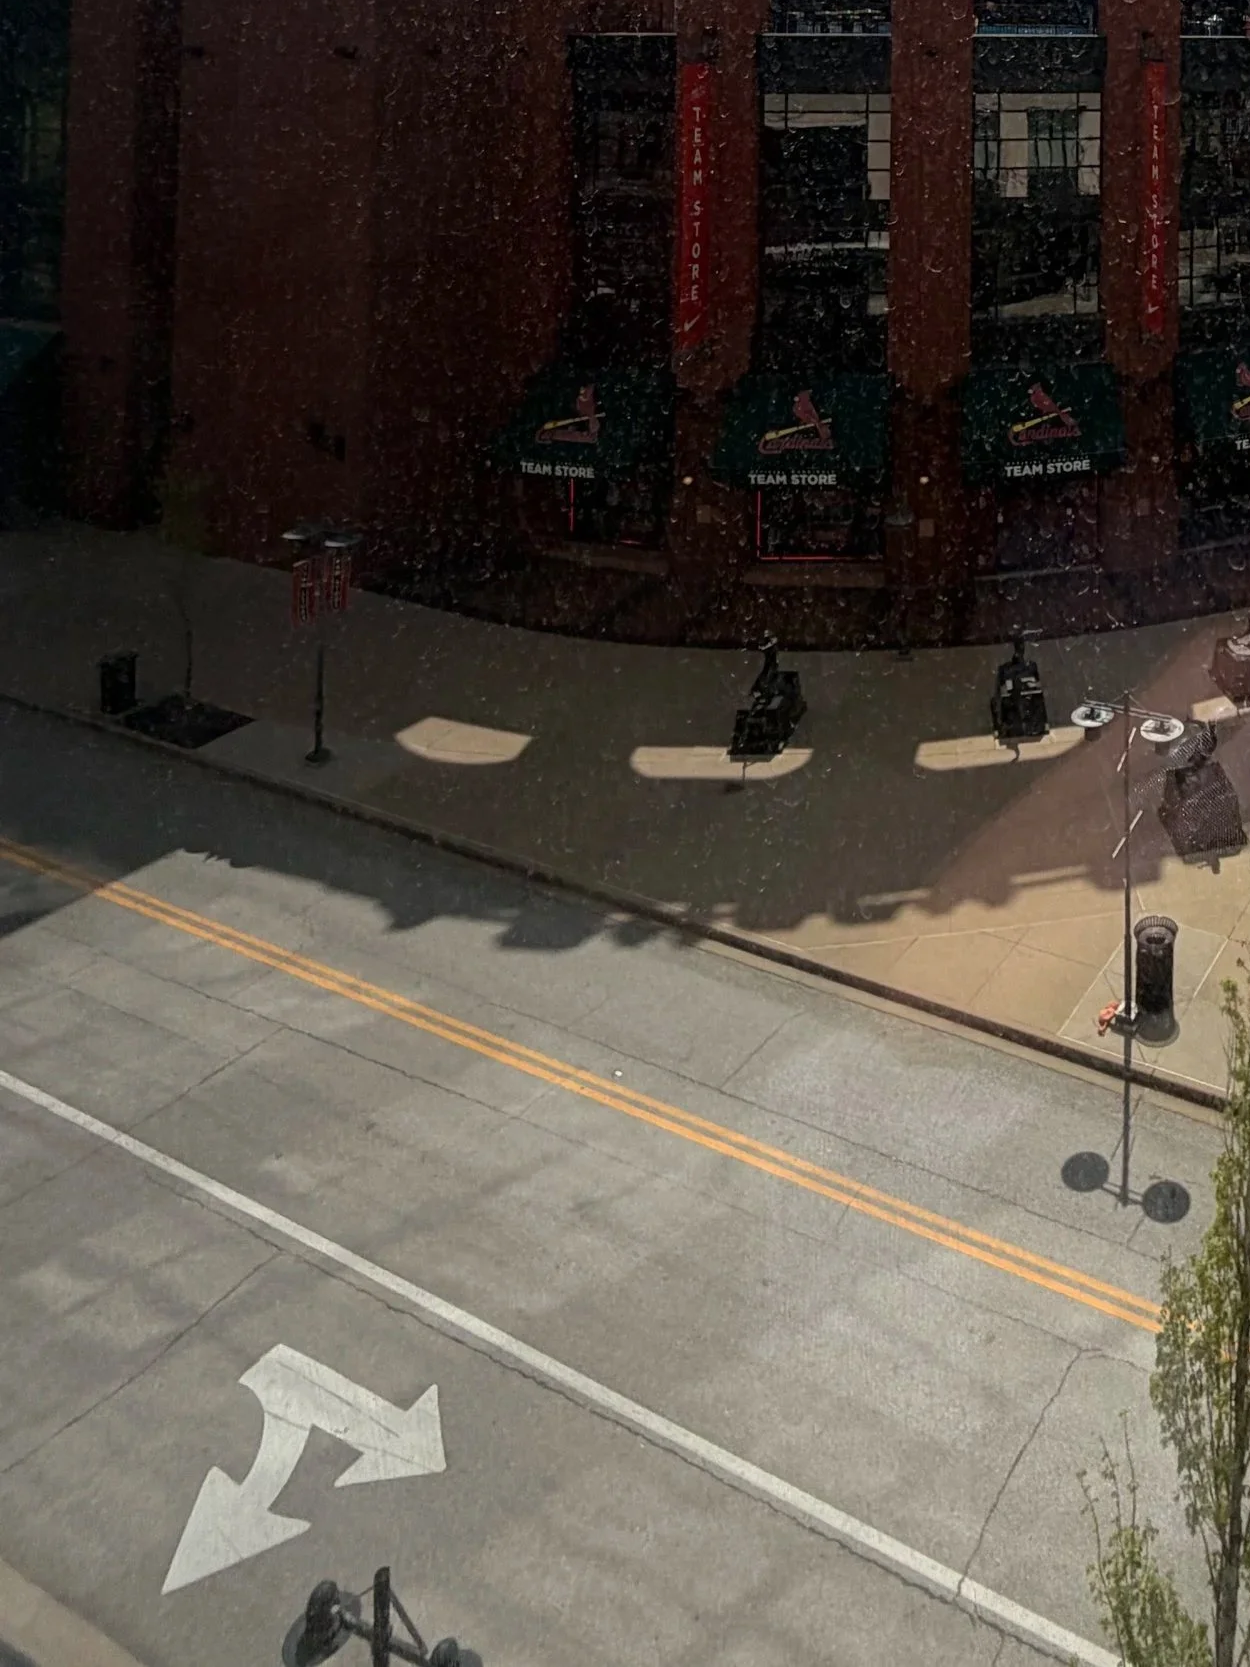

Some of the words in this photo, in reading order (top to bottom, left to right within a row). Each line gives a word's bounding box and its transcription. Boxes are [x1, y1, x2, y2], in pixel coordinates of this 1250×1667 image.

[692, 106, 703, 186] TEAM
[1152, 105, 1160, 180] TEAM
[691, 200, 702, 301] STORE
[1151, 193, 1159, 290] STORE
[520, 461, 552, 476] TEAM
[555, 464, 596, 479] STORE
[747, 473, 788, 486] TEAM
[790, 473, 838, 486] STORE
[1004, 464, 1043, 478] TEAM
[1046, 459, 1092, 475] STORE
